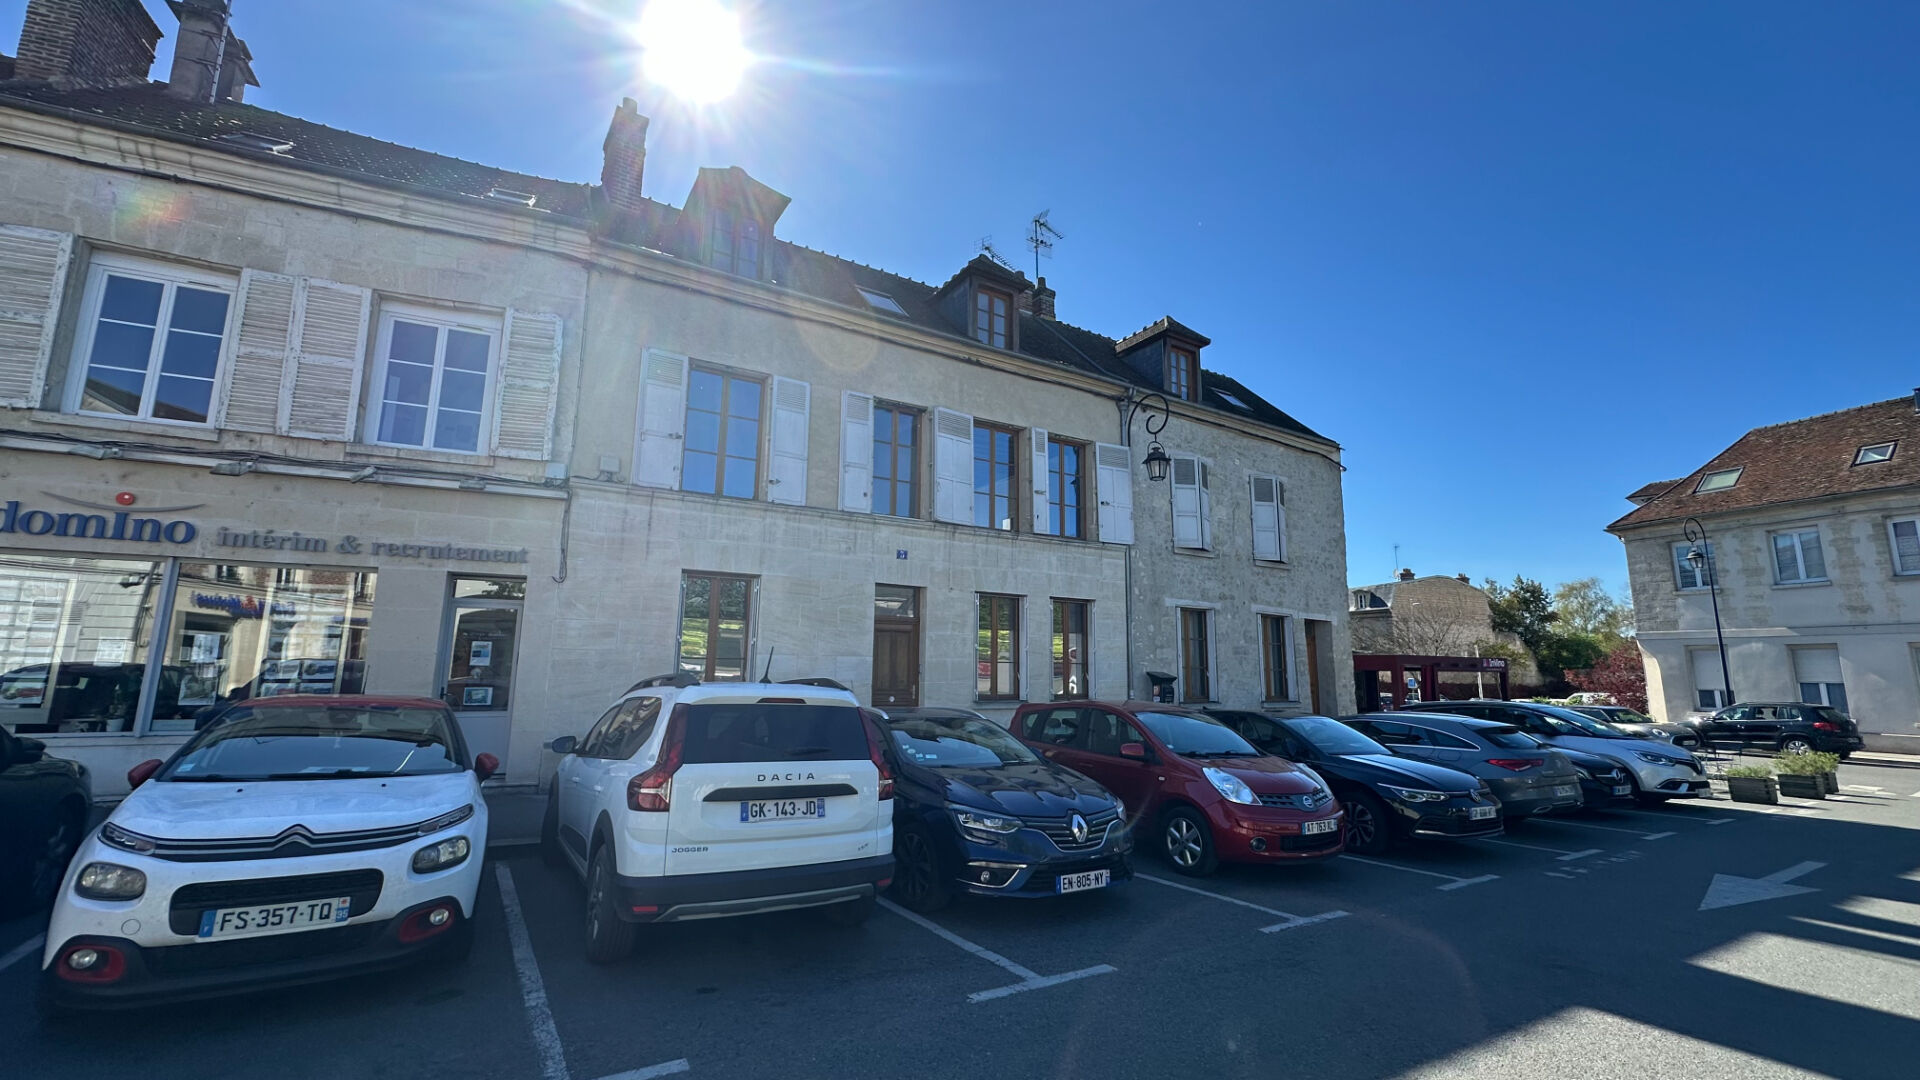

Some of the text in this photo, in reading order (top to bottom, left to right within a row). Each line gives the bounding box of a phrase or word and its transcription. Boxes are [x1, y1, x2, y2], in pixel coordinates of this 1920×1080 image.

[216, 527, 529, 564] intérim & recrutement
[757, 772, 815, 782] DACIA
[750, 800, 816, 818] GK-143-JD
[1062, 871, 1104, 890] EN-805-NY
[220, 902, 332, 931] FS-357-TQ
